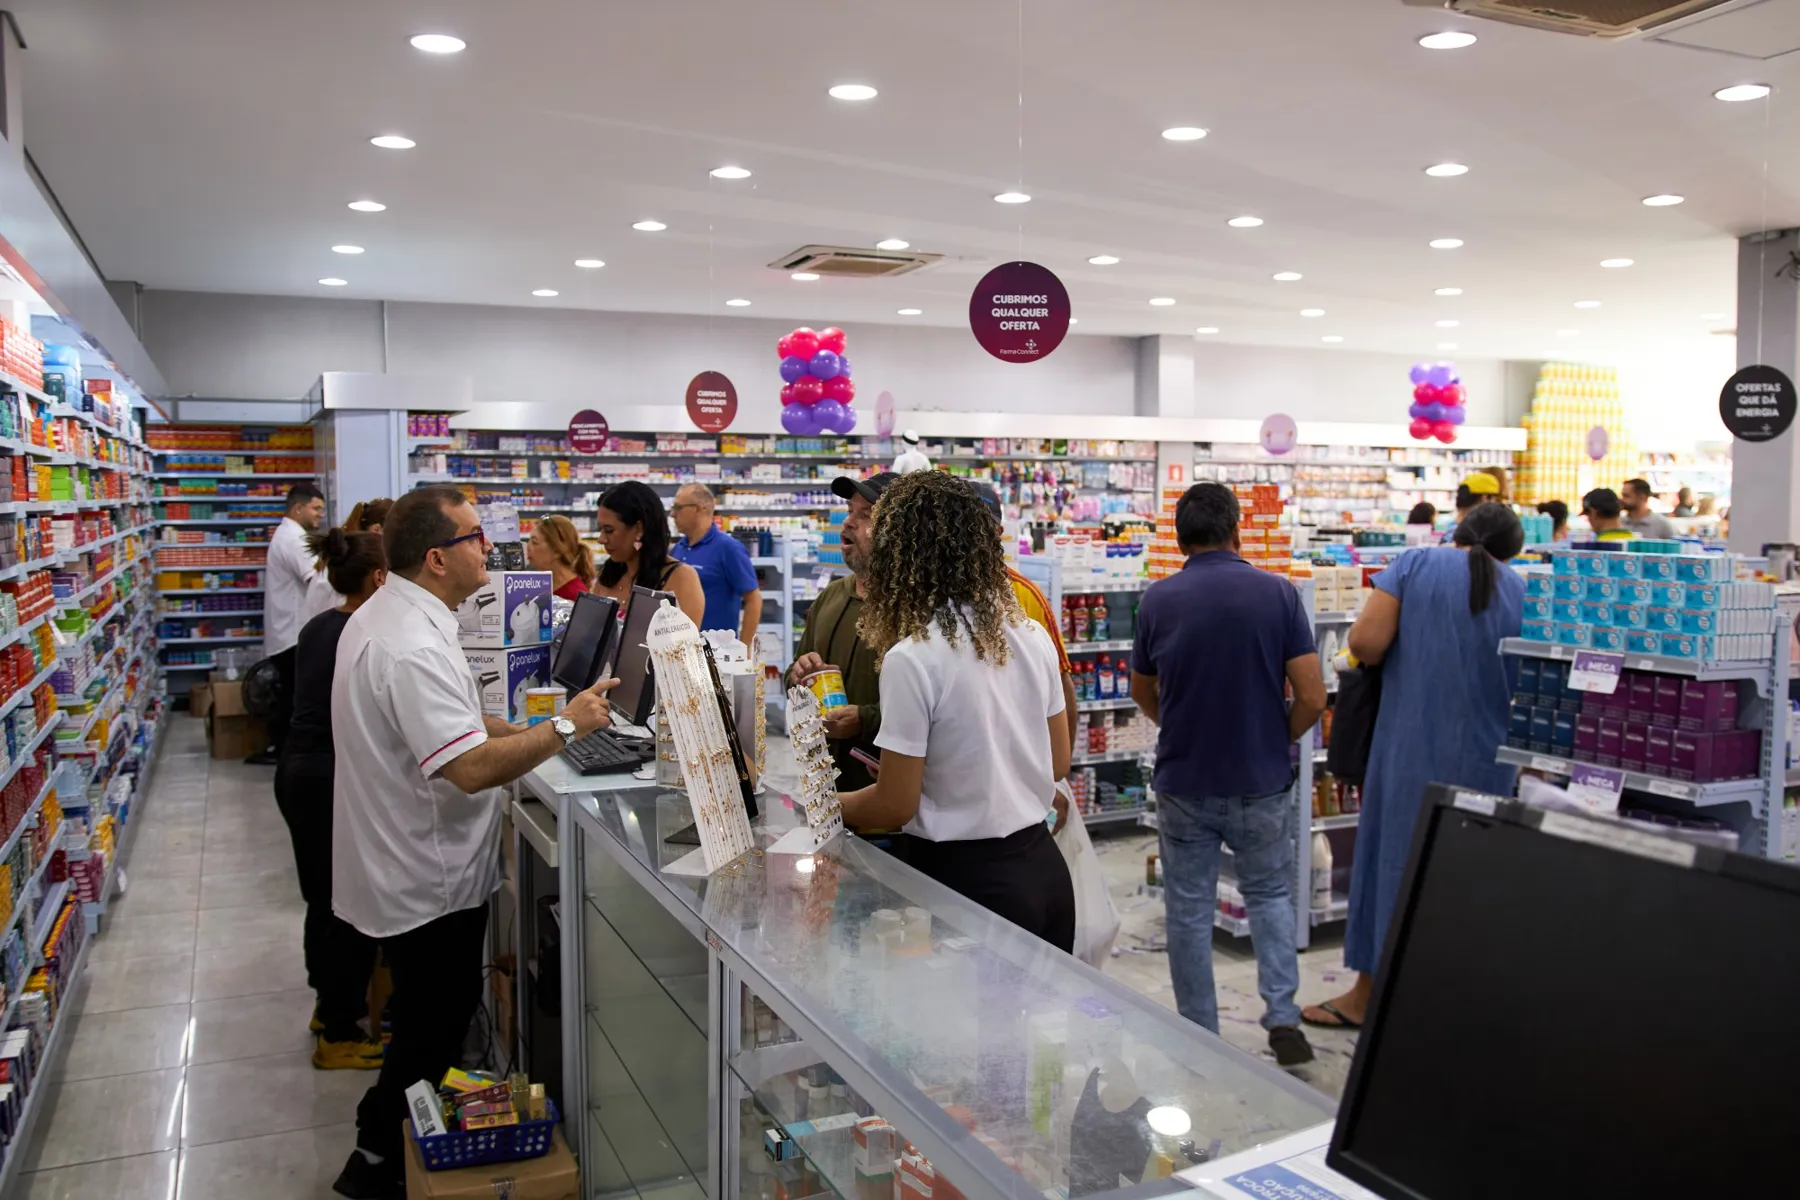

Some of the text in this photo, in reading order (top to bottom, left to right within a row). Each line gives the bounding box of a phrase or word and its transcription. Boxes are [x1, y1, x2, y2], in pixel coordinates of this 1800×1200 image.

[992, 294, 1048, 304] CUBRIMOS
[991, 308, 1049, 318] QUALQUER
[999, 321, 1040, 331] OFERTA
[1735, 383, 1782, 393] OFERTAS
[696, 398, 727, 406] QUALQUER
[1739, 395, 1760, 405] QUE
[700, 406, 723, 414] OFERTA
[1735, 407, 1780, 418] ENERGIA
[513, 578, 541, 591] panelux
[464, 656, 495, 664] anelux
[516, 651, 541, 669] panelux
[1588, 661, 1616, 673] MEGA
[1587, 775, 1614, 790] MEGA
